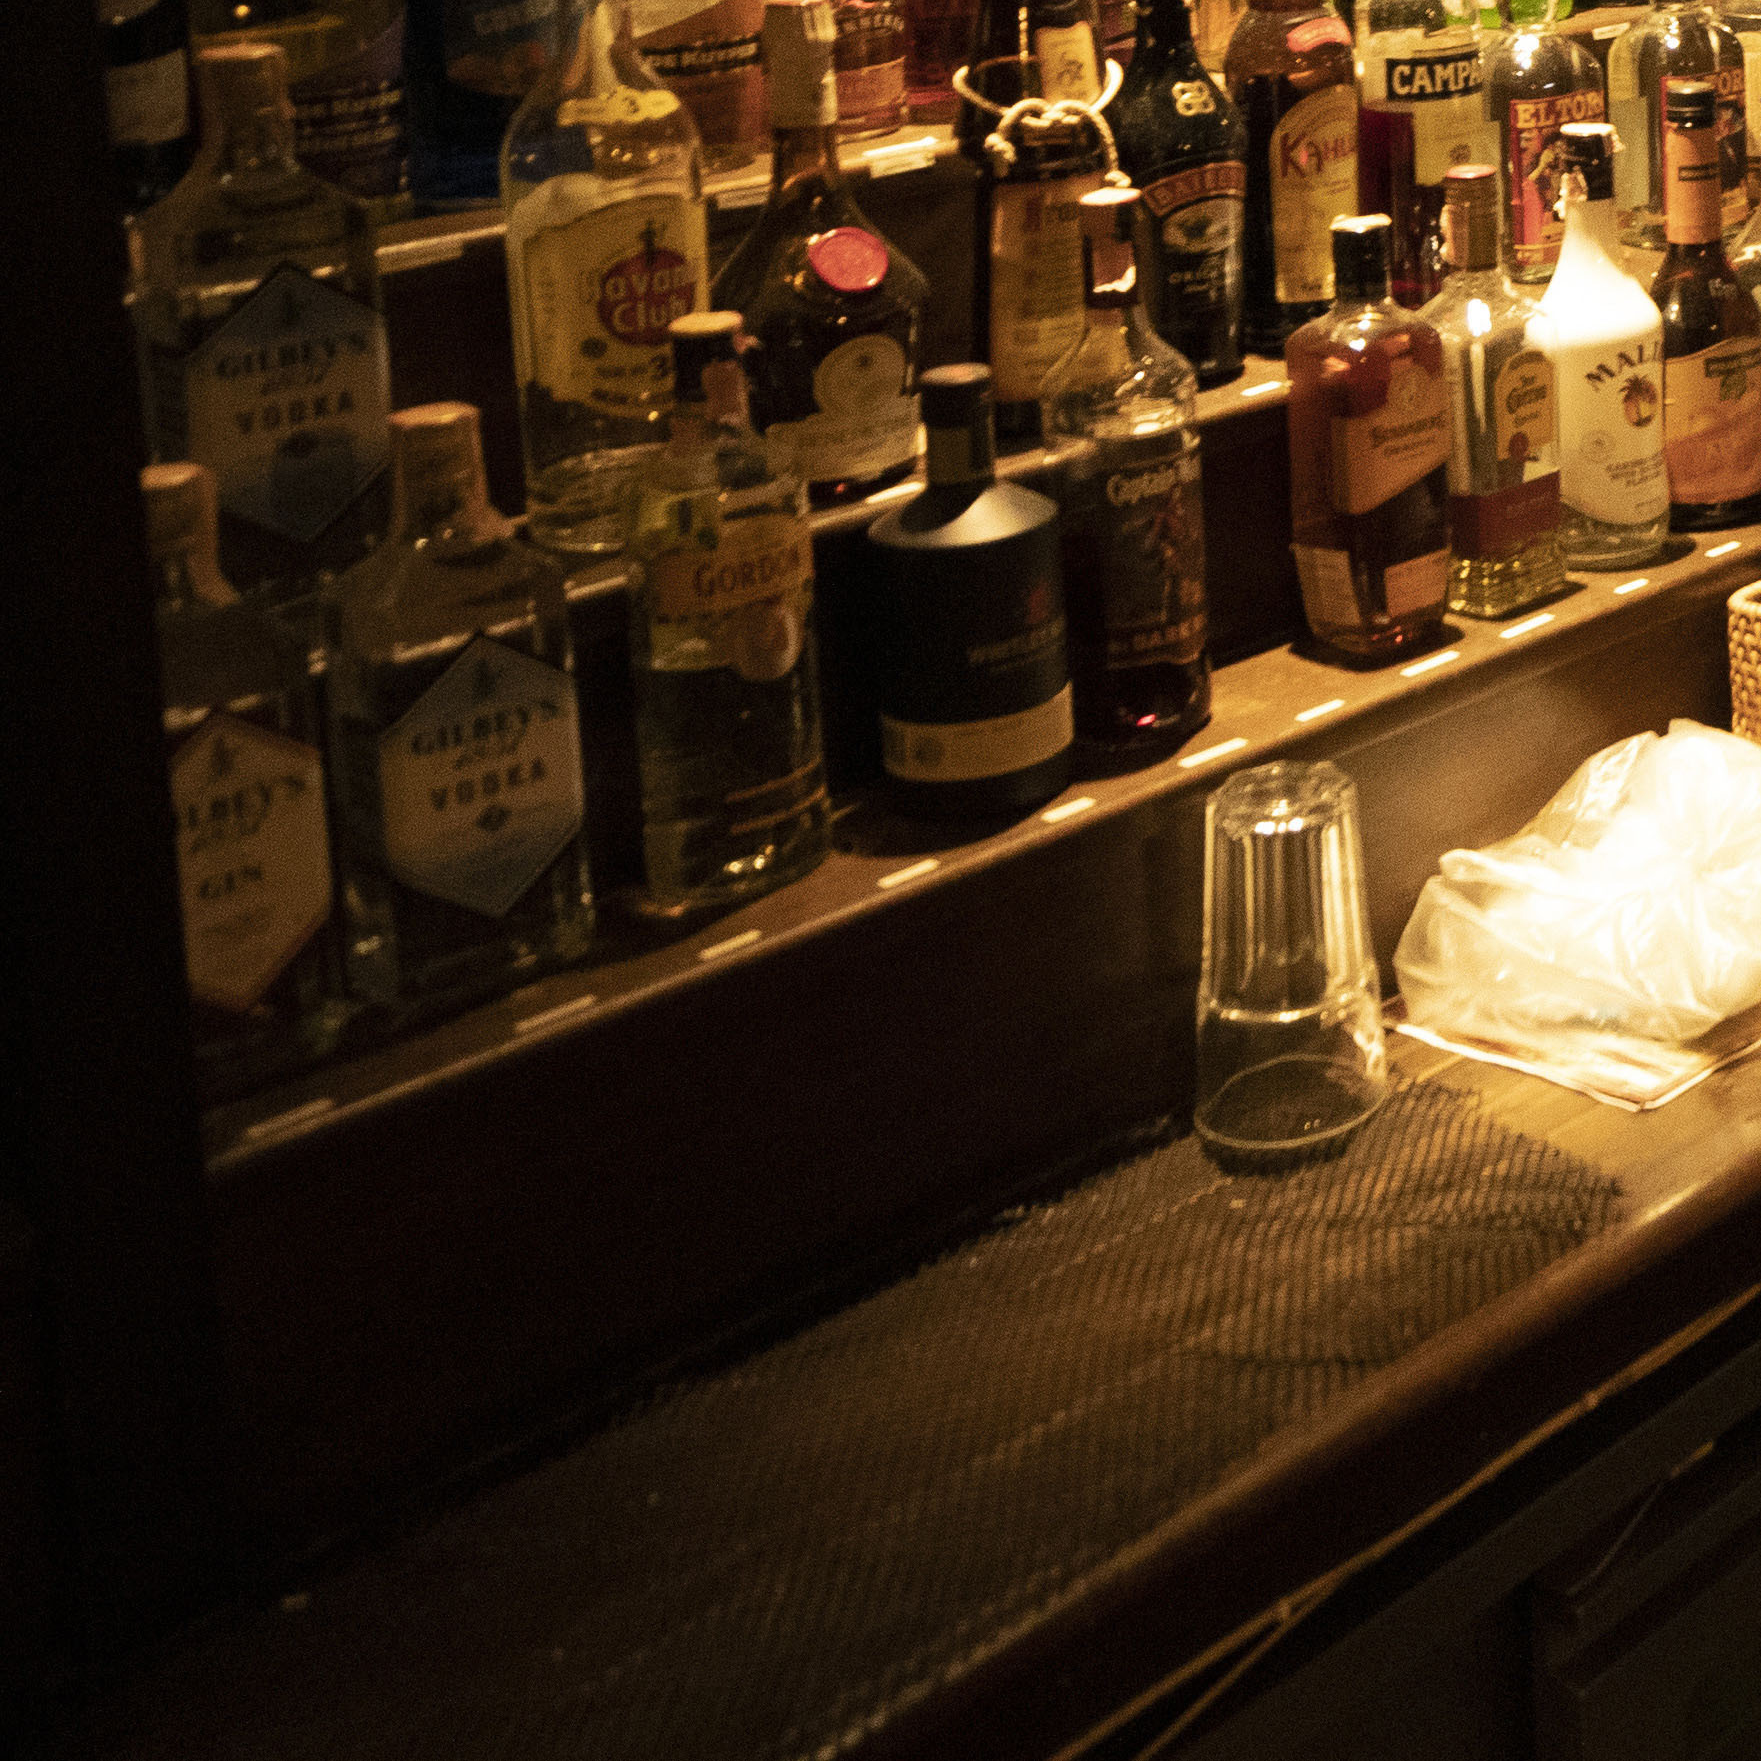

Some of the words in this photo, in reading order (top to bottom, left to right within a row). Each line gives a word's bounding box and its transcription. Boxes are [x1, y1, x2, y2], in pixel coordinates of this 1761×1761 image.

[1515, 101, 1553, 129] EL
[236, 389, 354, 435] VODKA
[431, 756, 547, 812] VODKA
